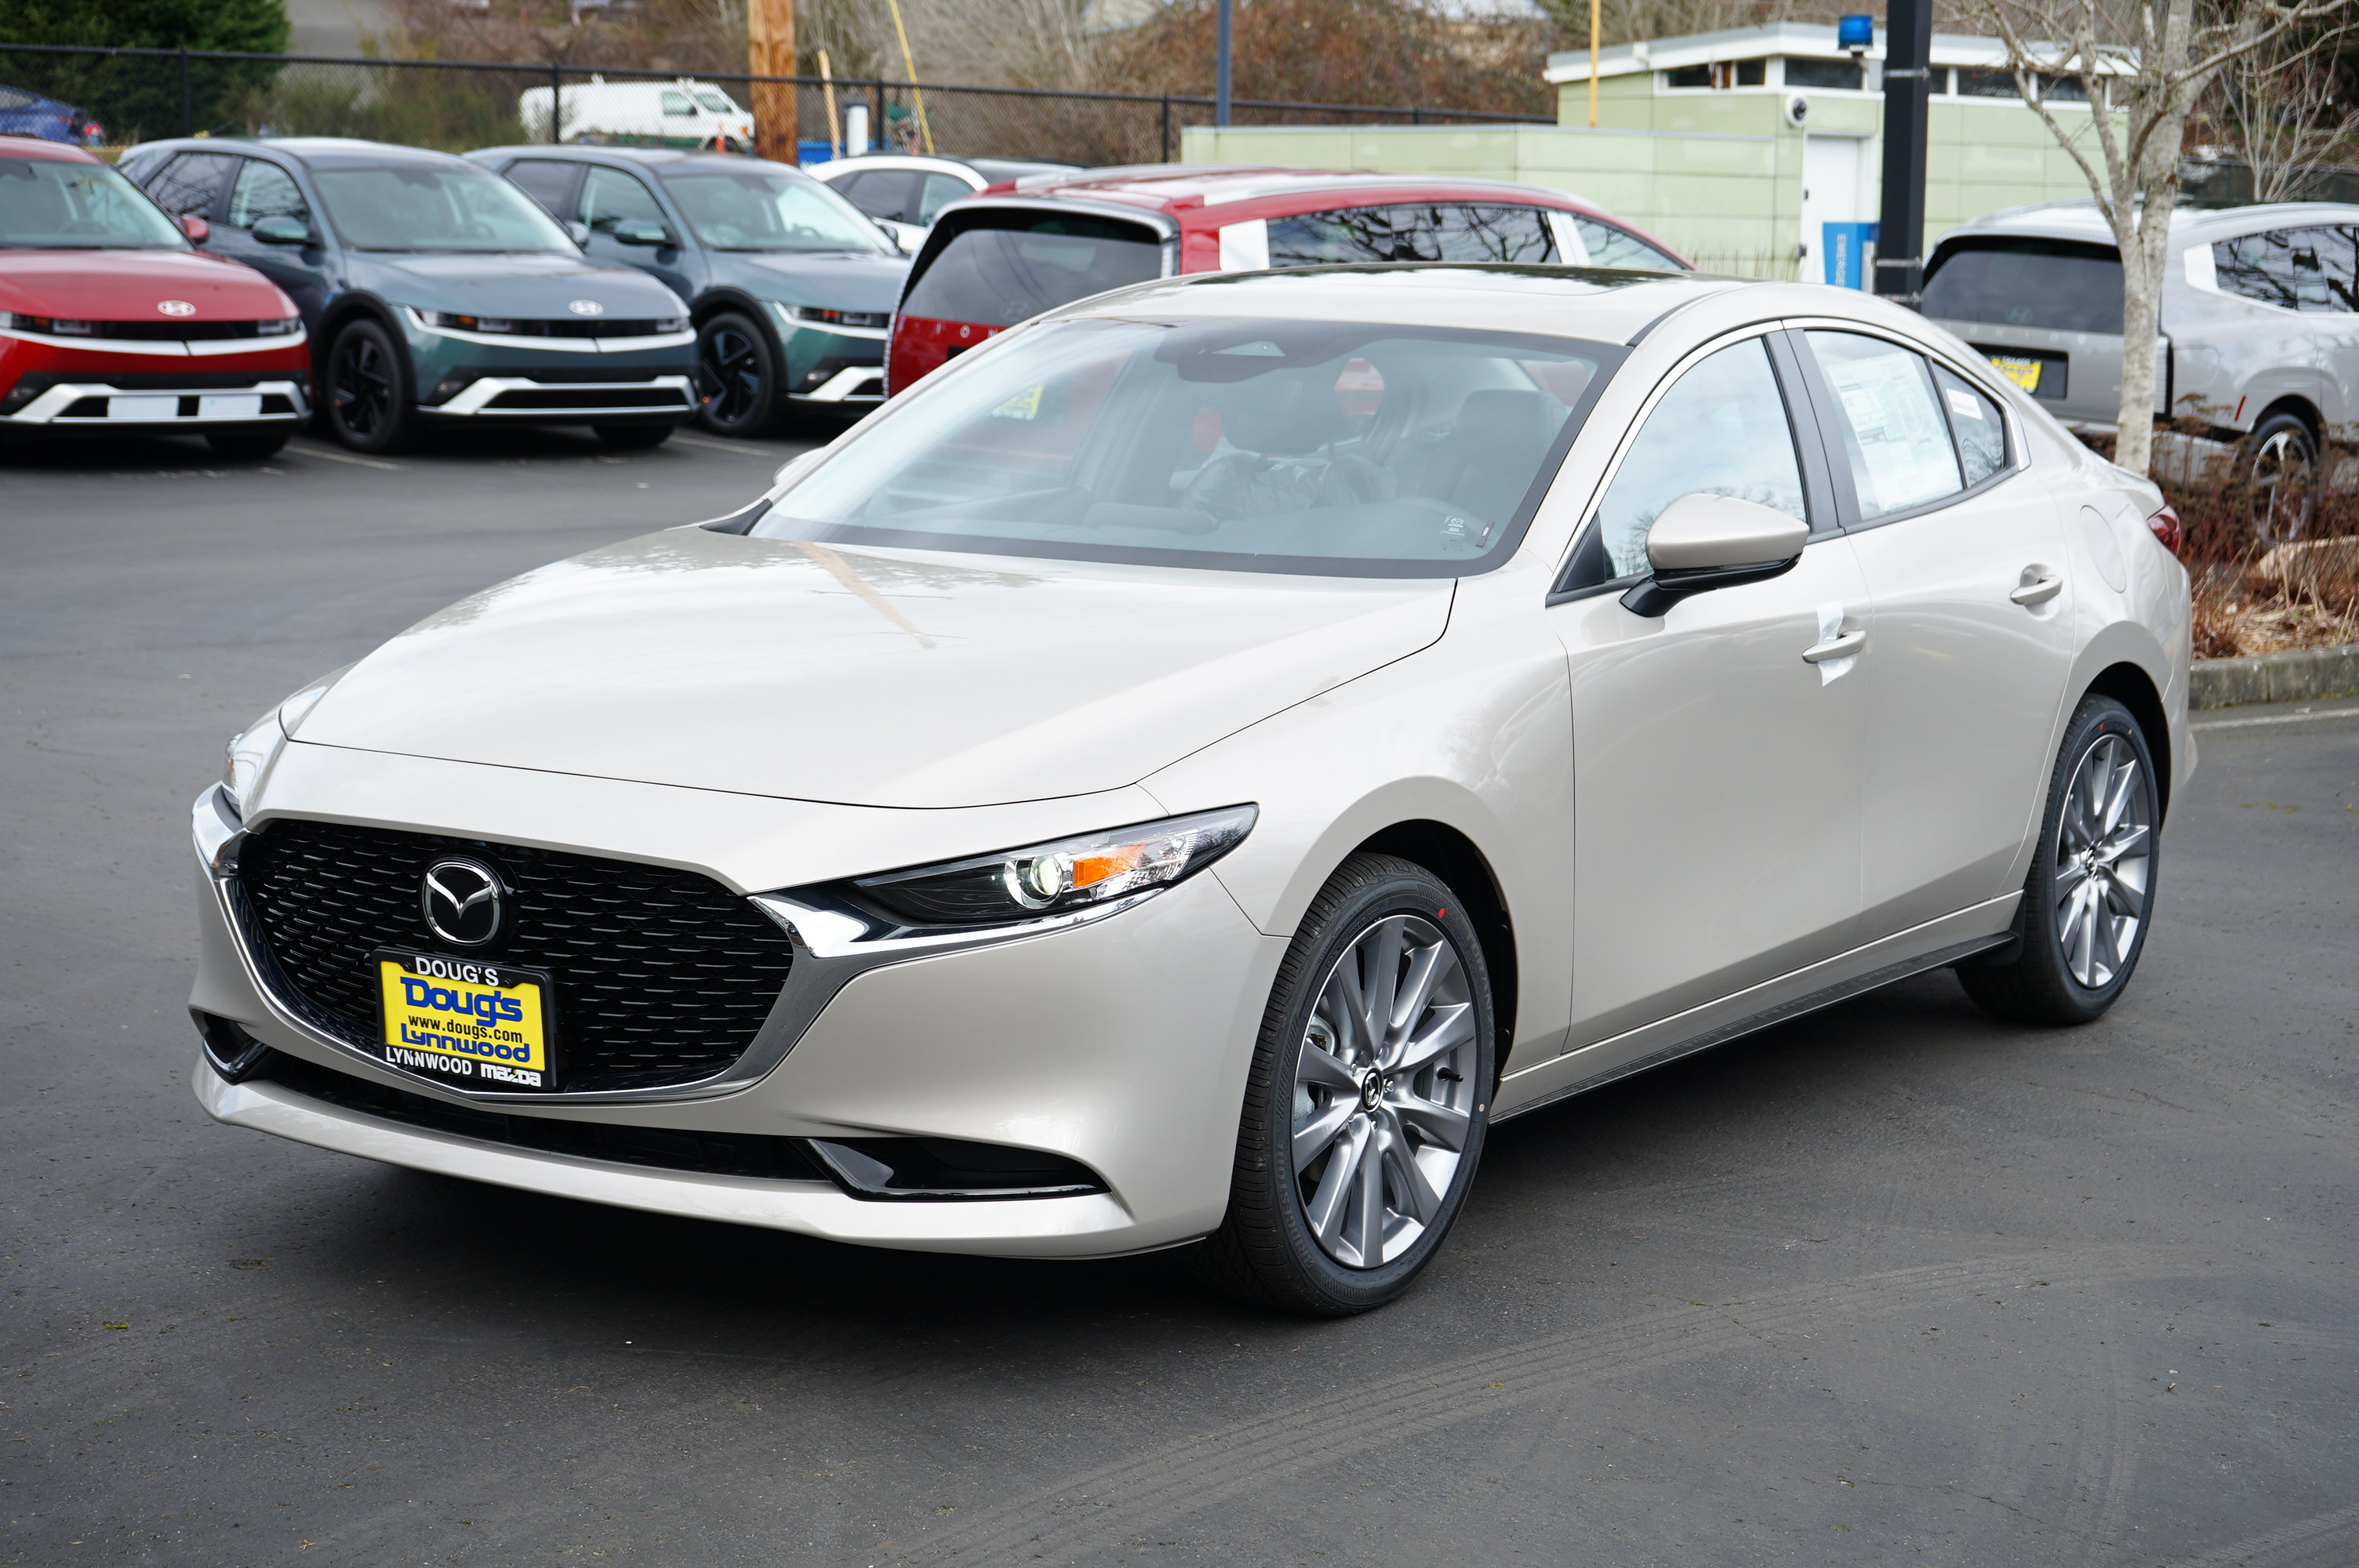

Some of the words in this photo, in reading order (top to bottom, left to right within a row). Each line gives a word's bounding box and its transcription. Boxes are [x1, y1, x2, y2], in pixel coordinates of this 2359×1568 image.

[1836, 233, 1847, 287] EMERGE
[415, 956, 500, 987] DOUG'S
[400, 1022, 531, 1063] Lynnwood
[408, 1014, 523, 1044] www.dougs.com
[385, 1046, 473, 1076] LYNNWOOD
